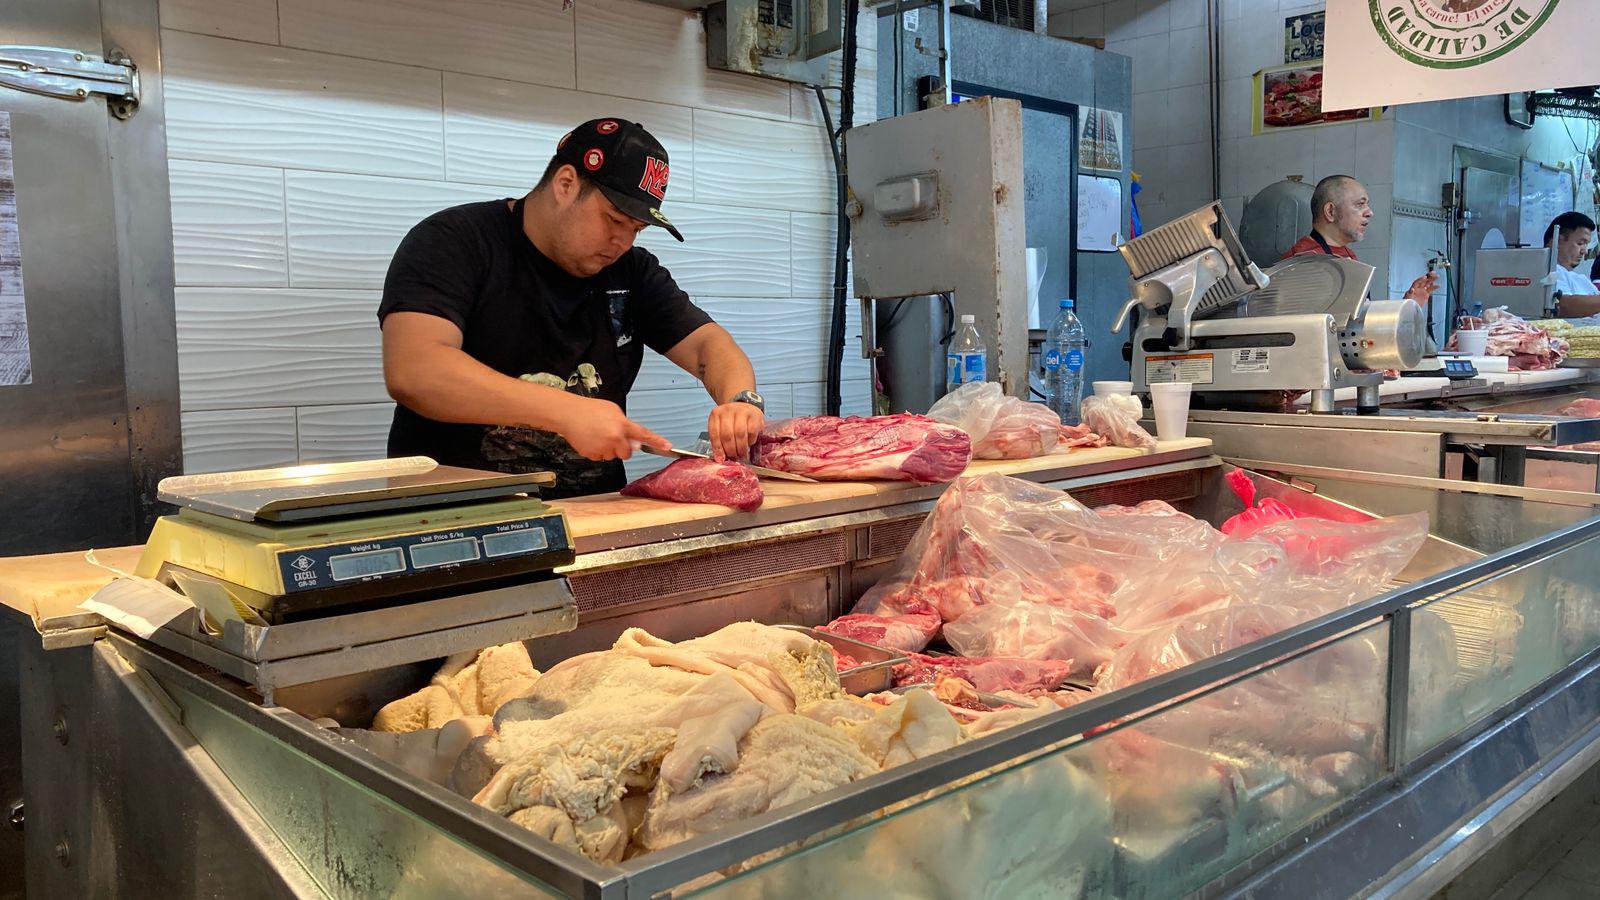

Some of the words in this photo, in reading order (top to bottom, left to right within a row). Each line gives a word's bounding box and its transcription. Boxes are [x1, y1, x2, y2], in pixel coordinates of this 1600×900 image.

[1425, 7, 1458, 23] carne!
[1466, 10, 1479, 22] El
[1494, 6, 1531, 40] DE
[1291, 22, 1325, 39] LOC
[1387, 6, 1487, 55] CALIDAD
[350, 544, 371, 552] Weight
[293, 571, 317, 582] EXCELL
